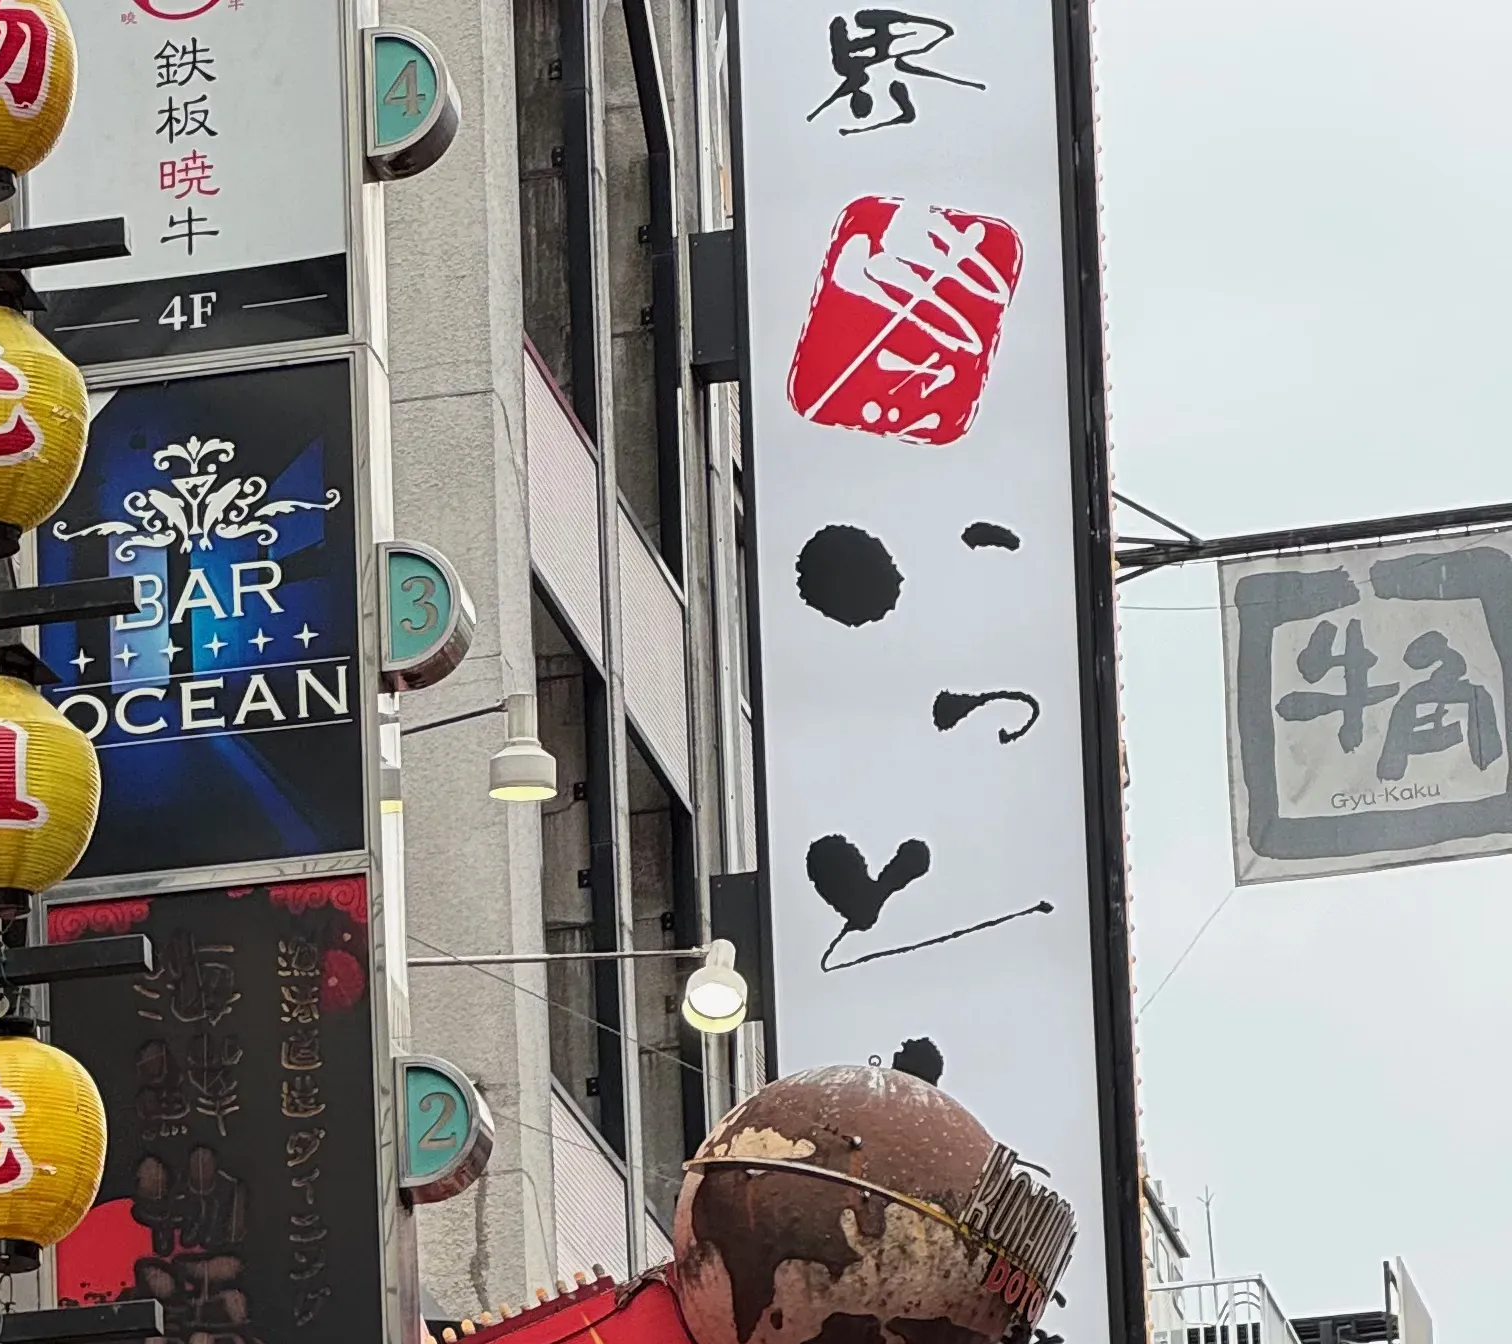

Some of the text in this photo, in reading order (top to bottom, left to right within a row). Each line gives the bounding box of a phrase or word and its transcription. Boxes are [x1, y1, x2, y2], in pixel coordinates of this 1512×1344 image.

[383, 60, 425, 118] 4
[159, 292, 216, 330] 4F
[115, 560, 284, 634] BAR
[400, 578, 438, 635] 3
[58, 665, 352, 740] OCEAN
[1276, 617, 1502, 781] 牛角
[418, 1093, 459, 1151] 2
